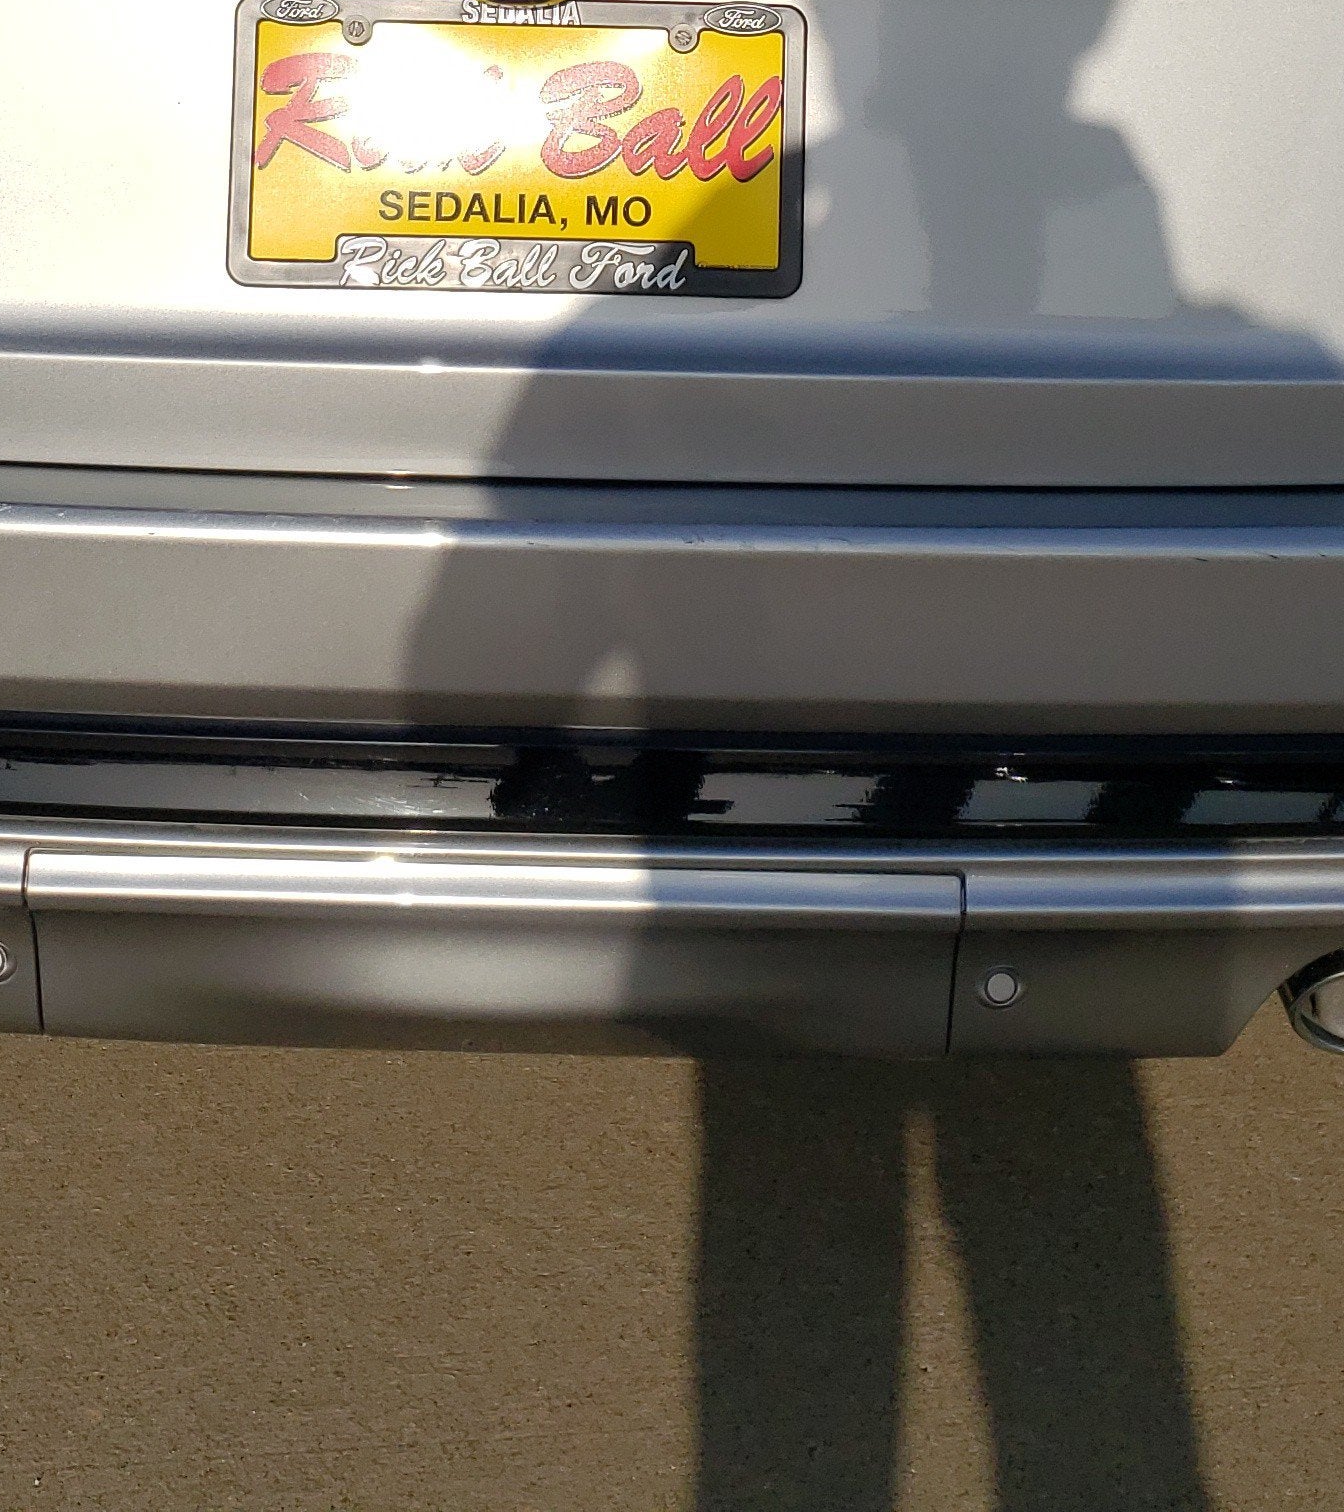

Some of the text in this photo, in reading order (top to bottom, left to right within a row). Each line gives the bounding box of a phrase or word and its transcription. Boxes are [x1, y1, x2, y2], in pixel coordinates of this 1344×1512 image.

[718, 9, 767, 30] Ford
[539, 60, 784, 184] Ball
[378, 189, 653, 231] SEDALIA, MO
[339, 236, 689, 291] Rick Ball Ford
